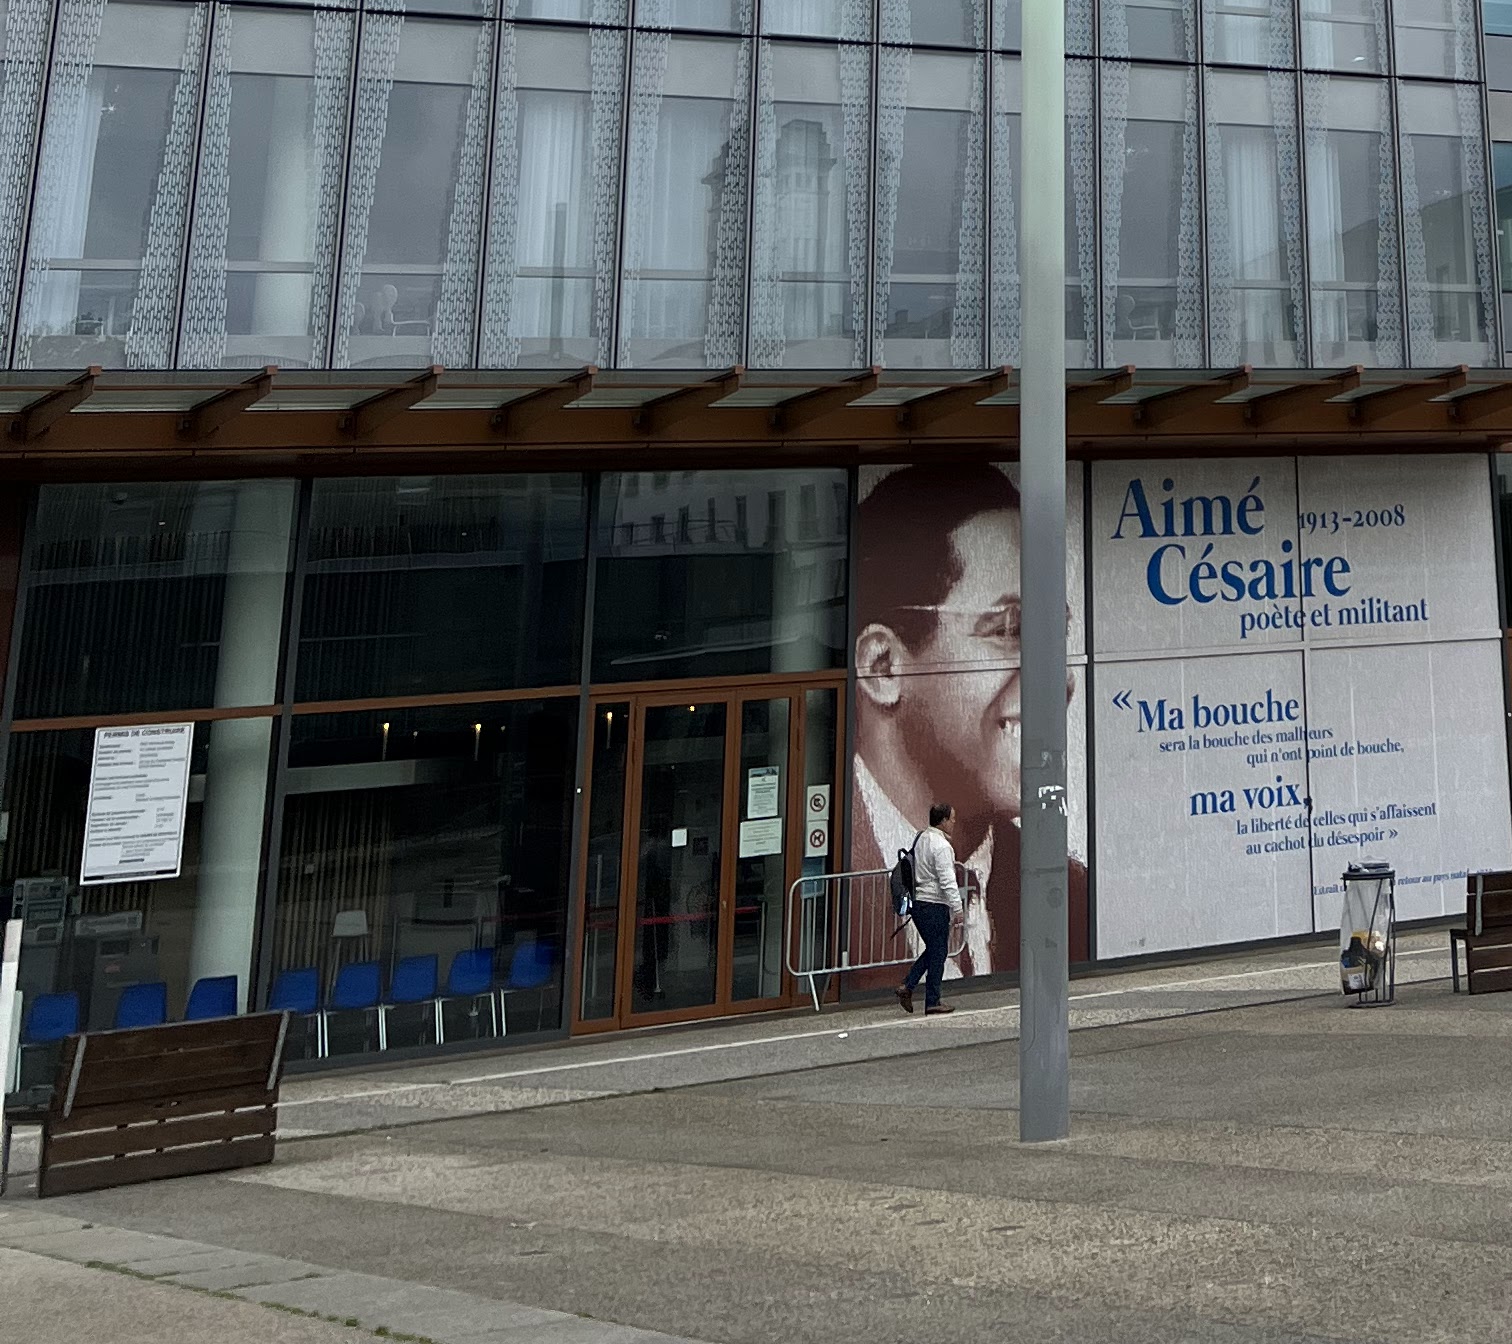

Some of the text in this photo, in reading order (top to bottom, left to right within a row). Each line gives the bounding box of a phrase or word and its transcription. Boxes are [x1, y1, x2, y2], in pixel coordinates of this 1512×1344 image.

[1111, 476, 1264, 539] Aimé
[1299, 504, 1405, 534] 1913-2008
[1147, 539, 1351, 605] Césaire
[1240, 597, 1429, 639] poète et militant
[1192, 688, 1300, 729] bouche
[1159, 739, 1186, 753] sera
[1189, 735, 1200, 750] la
[1203, 731, 1249, 749] bouche
[1252, 730, 1273, 745] des
[1247, 749, 1268, 768] qui
[1271, 747, 1302, 763] n'ont
[1340, 741, 1354, 756] de
[1357, 738, 1404, 756] bouche,
[1190, 789, 1236, 816] ma
[1237, 803, 1436, 835] la liberté de celles qui s'affaissent
[1246, 844, 1261, 855] au
[1265, 836, 1305, 852] cachot
[1327, 828, 1384, 846] désespoir
